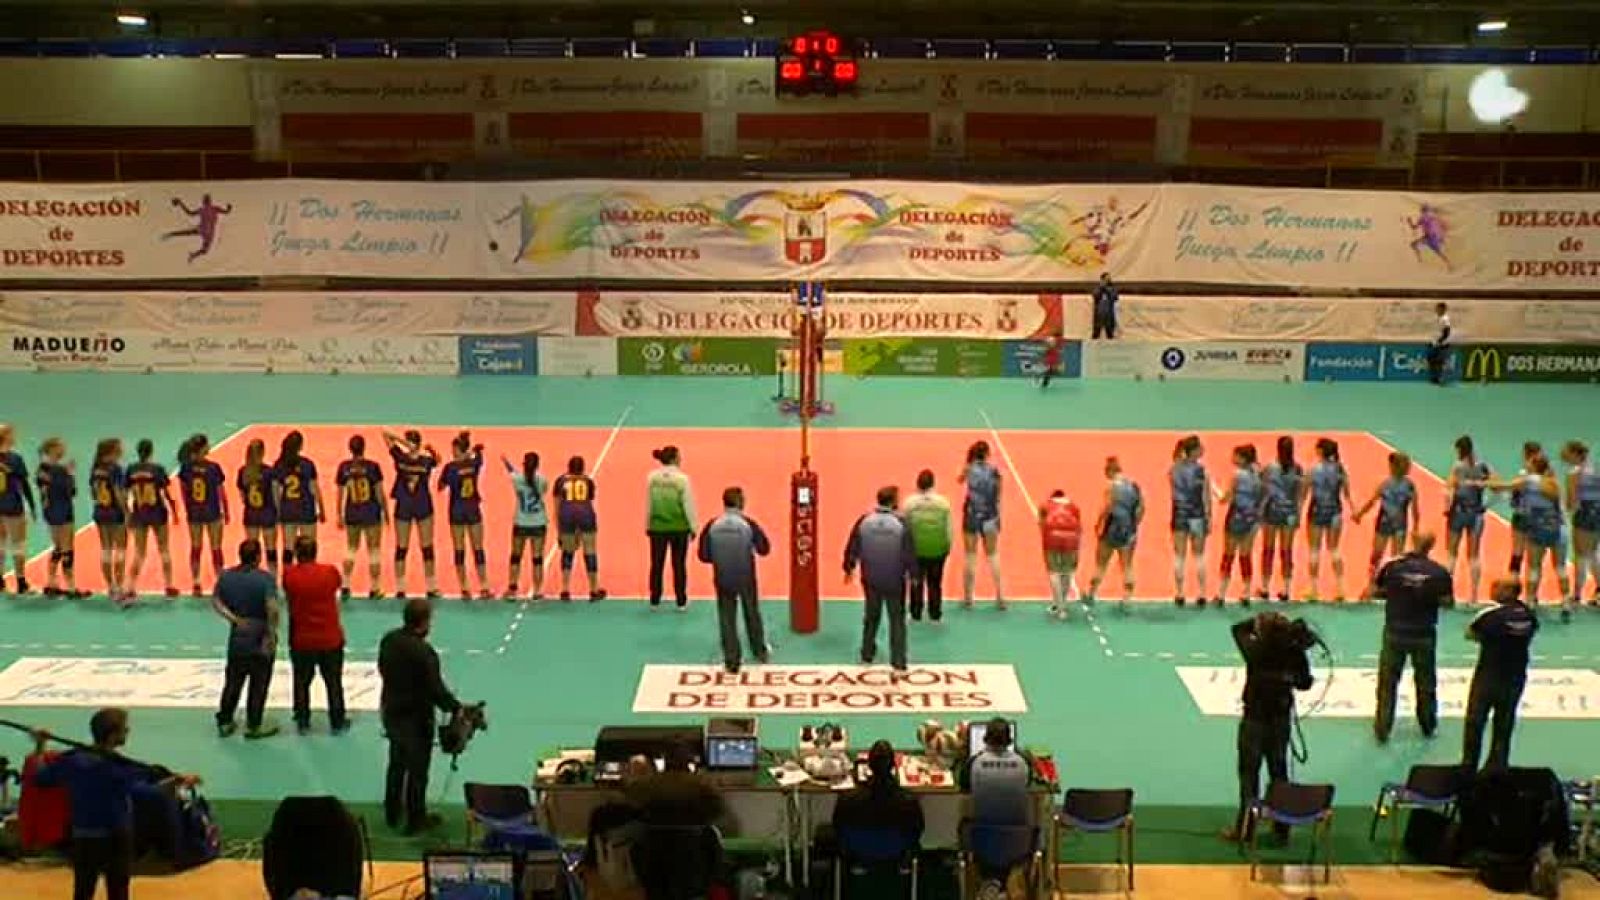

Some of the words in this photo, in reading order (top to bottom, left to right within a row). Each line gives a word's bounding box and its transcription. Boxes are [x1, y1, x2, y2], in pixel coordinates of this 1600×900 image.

[50, 224, 74, 242] de
[1558, 236, 1584, 252] de
[4, 249, 125, 266] DEPORTES
[860, 311, 984, 331] DEPORTES
[285, 474, 300, 498] 2
[563, 480, 590, 501] 10
[667, 691, 728, 708] DE
[746, 691, 993, 708] DEPORTES
